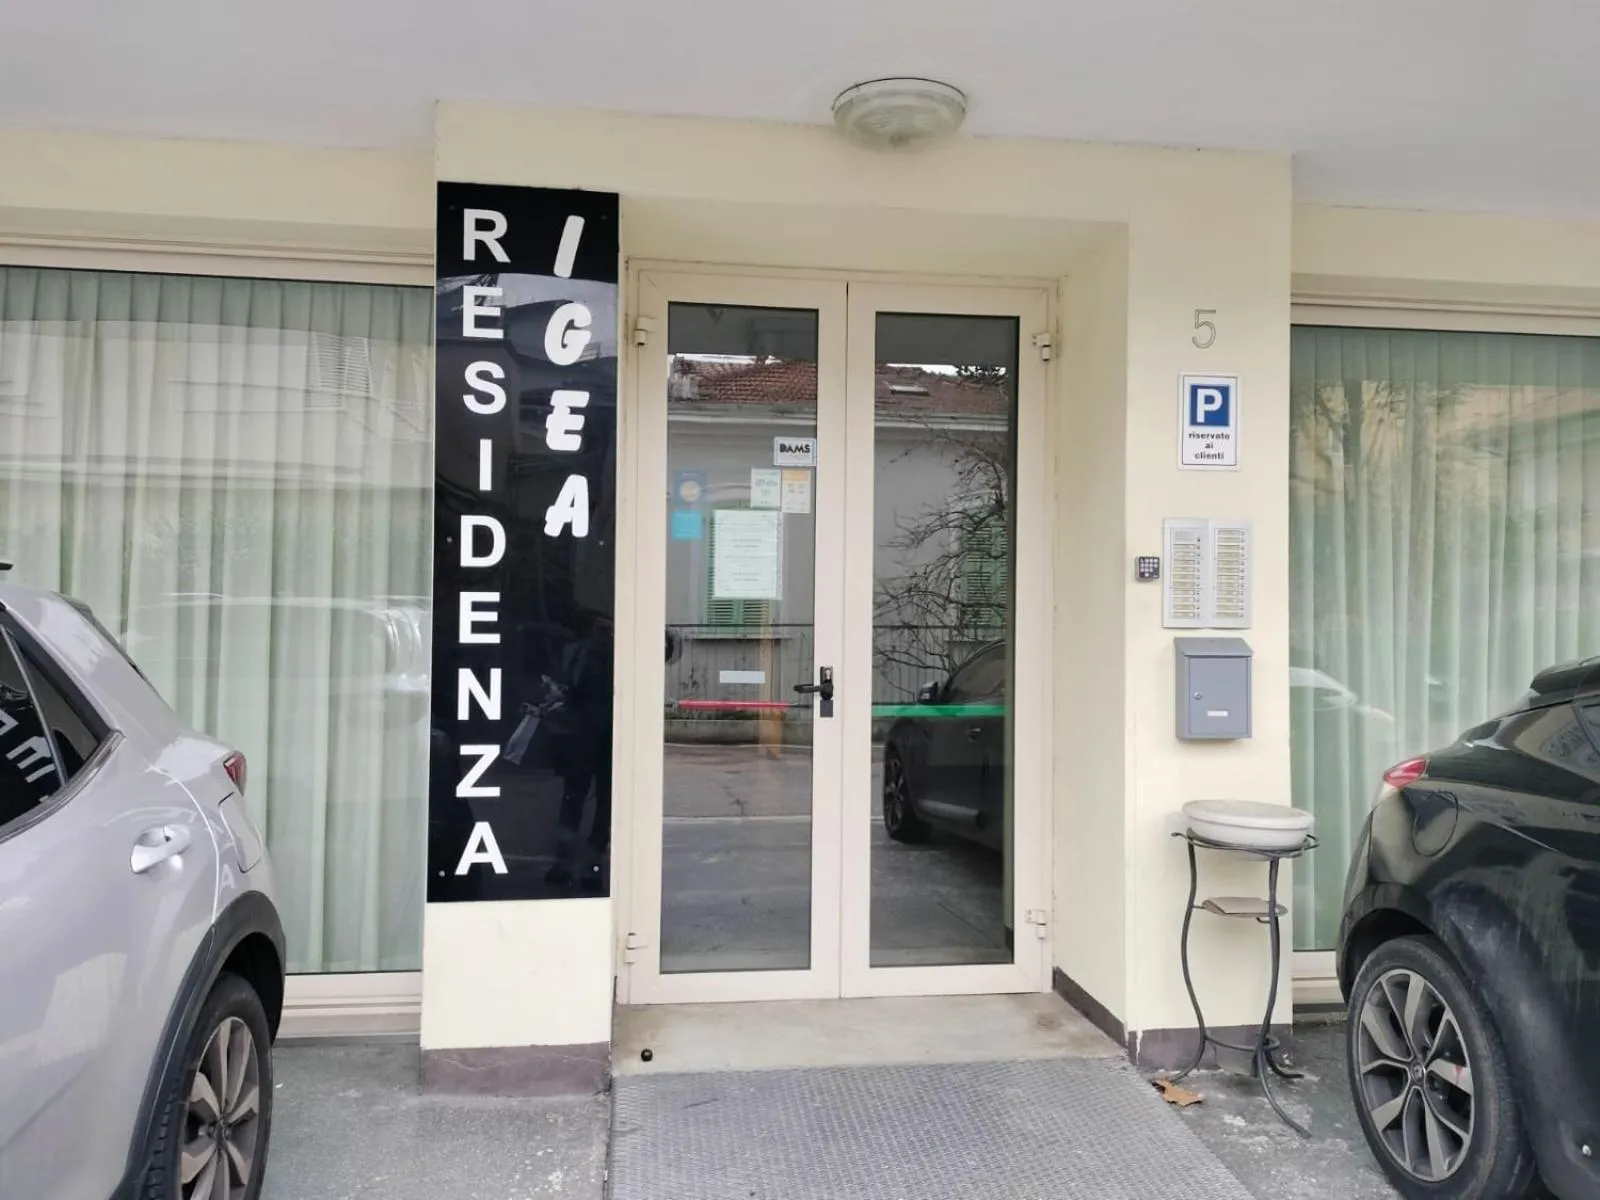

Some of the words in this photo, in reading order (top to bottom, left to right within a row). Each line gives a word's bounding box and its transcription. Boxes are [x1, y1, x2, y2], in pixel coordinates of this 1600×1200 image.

[1191, 309, 1217, 349] 5
[544, 214, 592, 538] IGEA
[1196, 388, 1223, 423] P
[1188, 431, 1230, 440] riservato
[1204, 441, 1214, 449] ai
[1194, 451, 1224, 460] clienti
[454, 208, 511, 875] RESIDENZA
